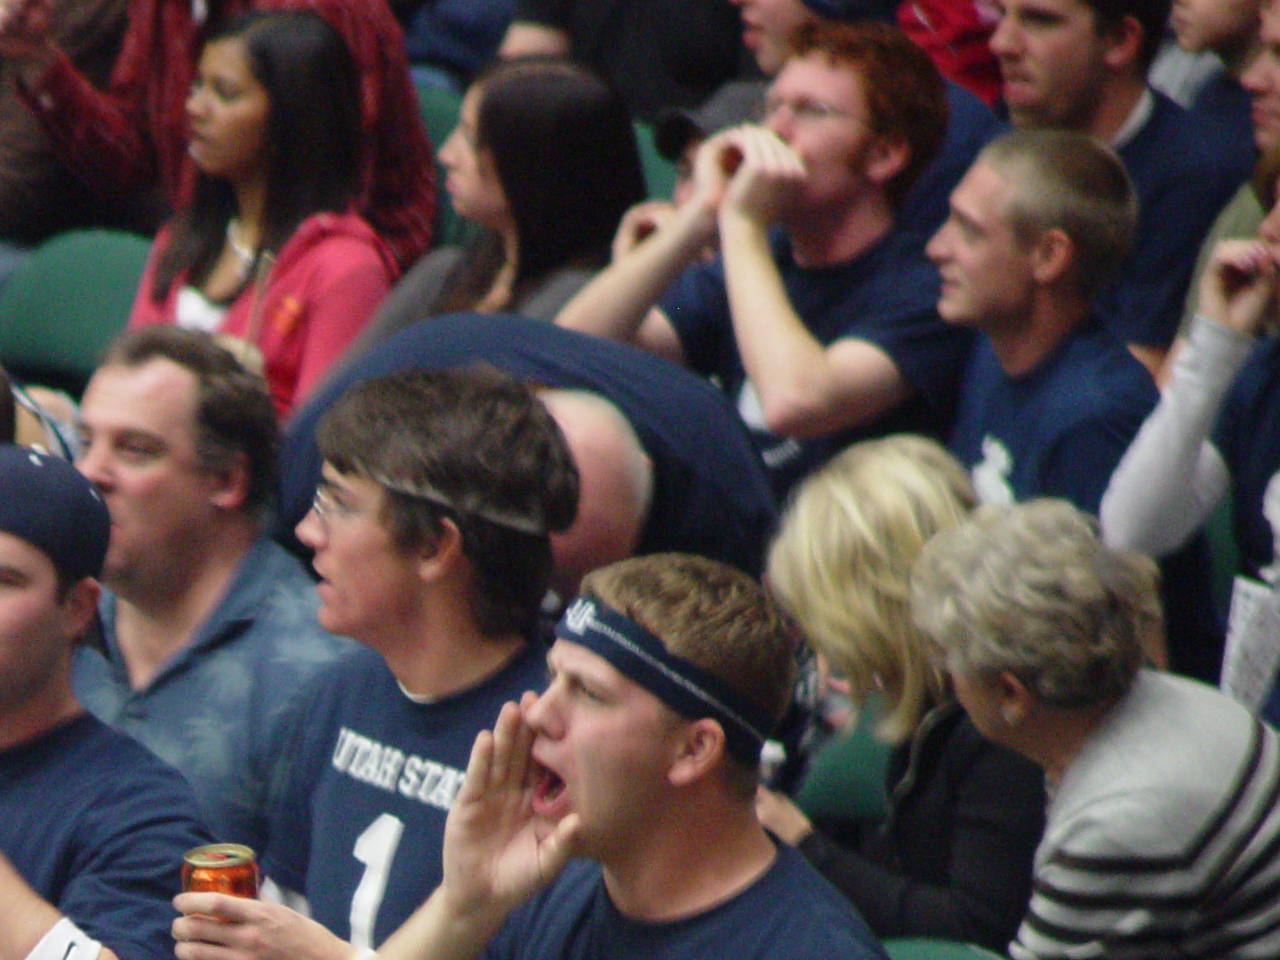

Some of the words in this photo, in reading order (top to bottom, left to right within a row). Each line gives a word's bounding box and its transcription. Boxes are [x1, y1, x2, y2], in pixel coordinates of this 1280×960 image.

[332, 727, 405, 793] UTAH
[398, 754, 468, 811] STA
[349, 813, 406, 952] 1
